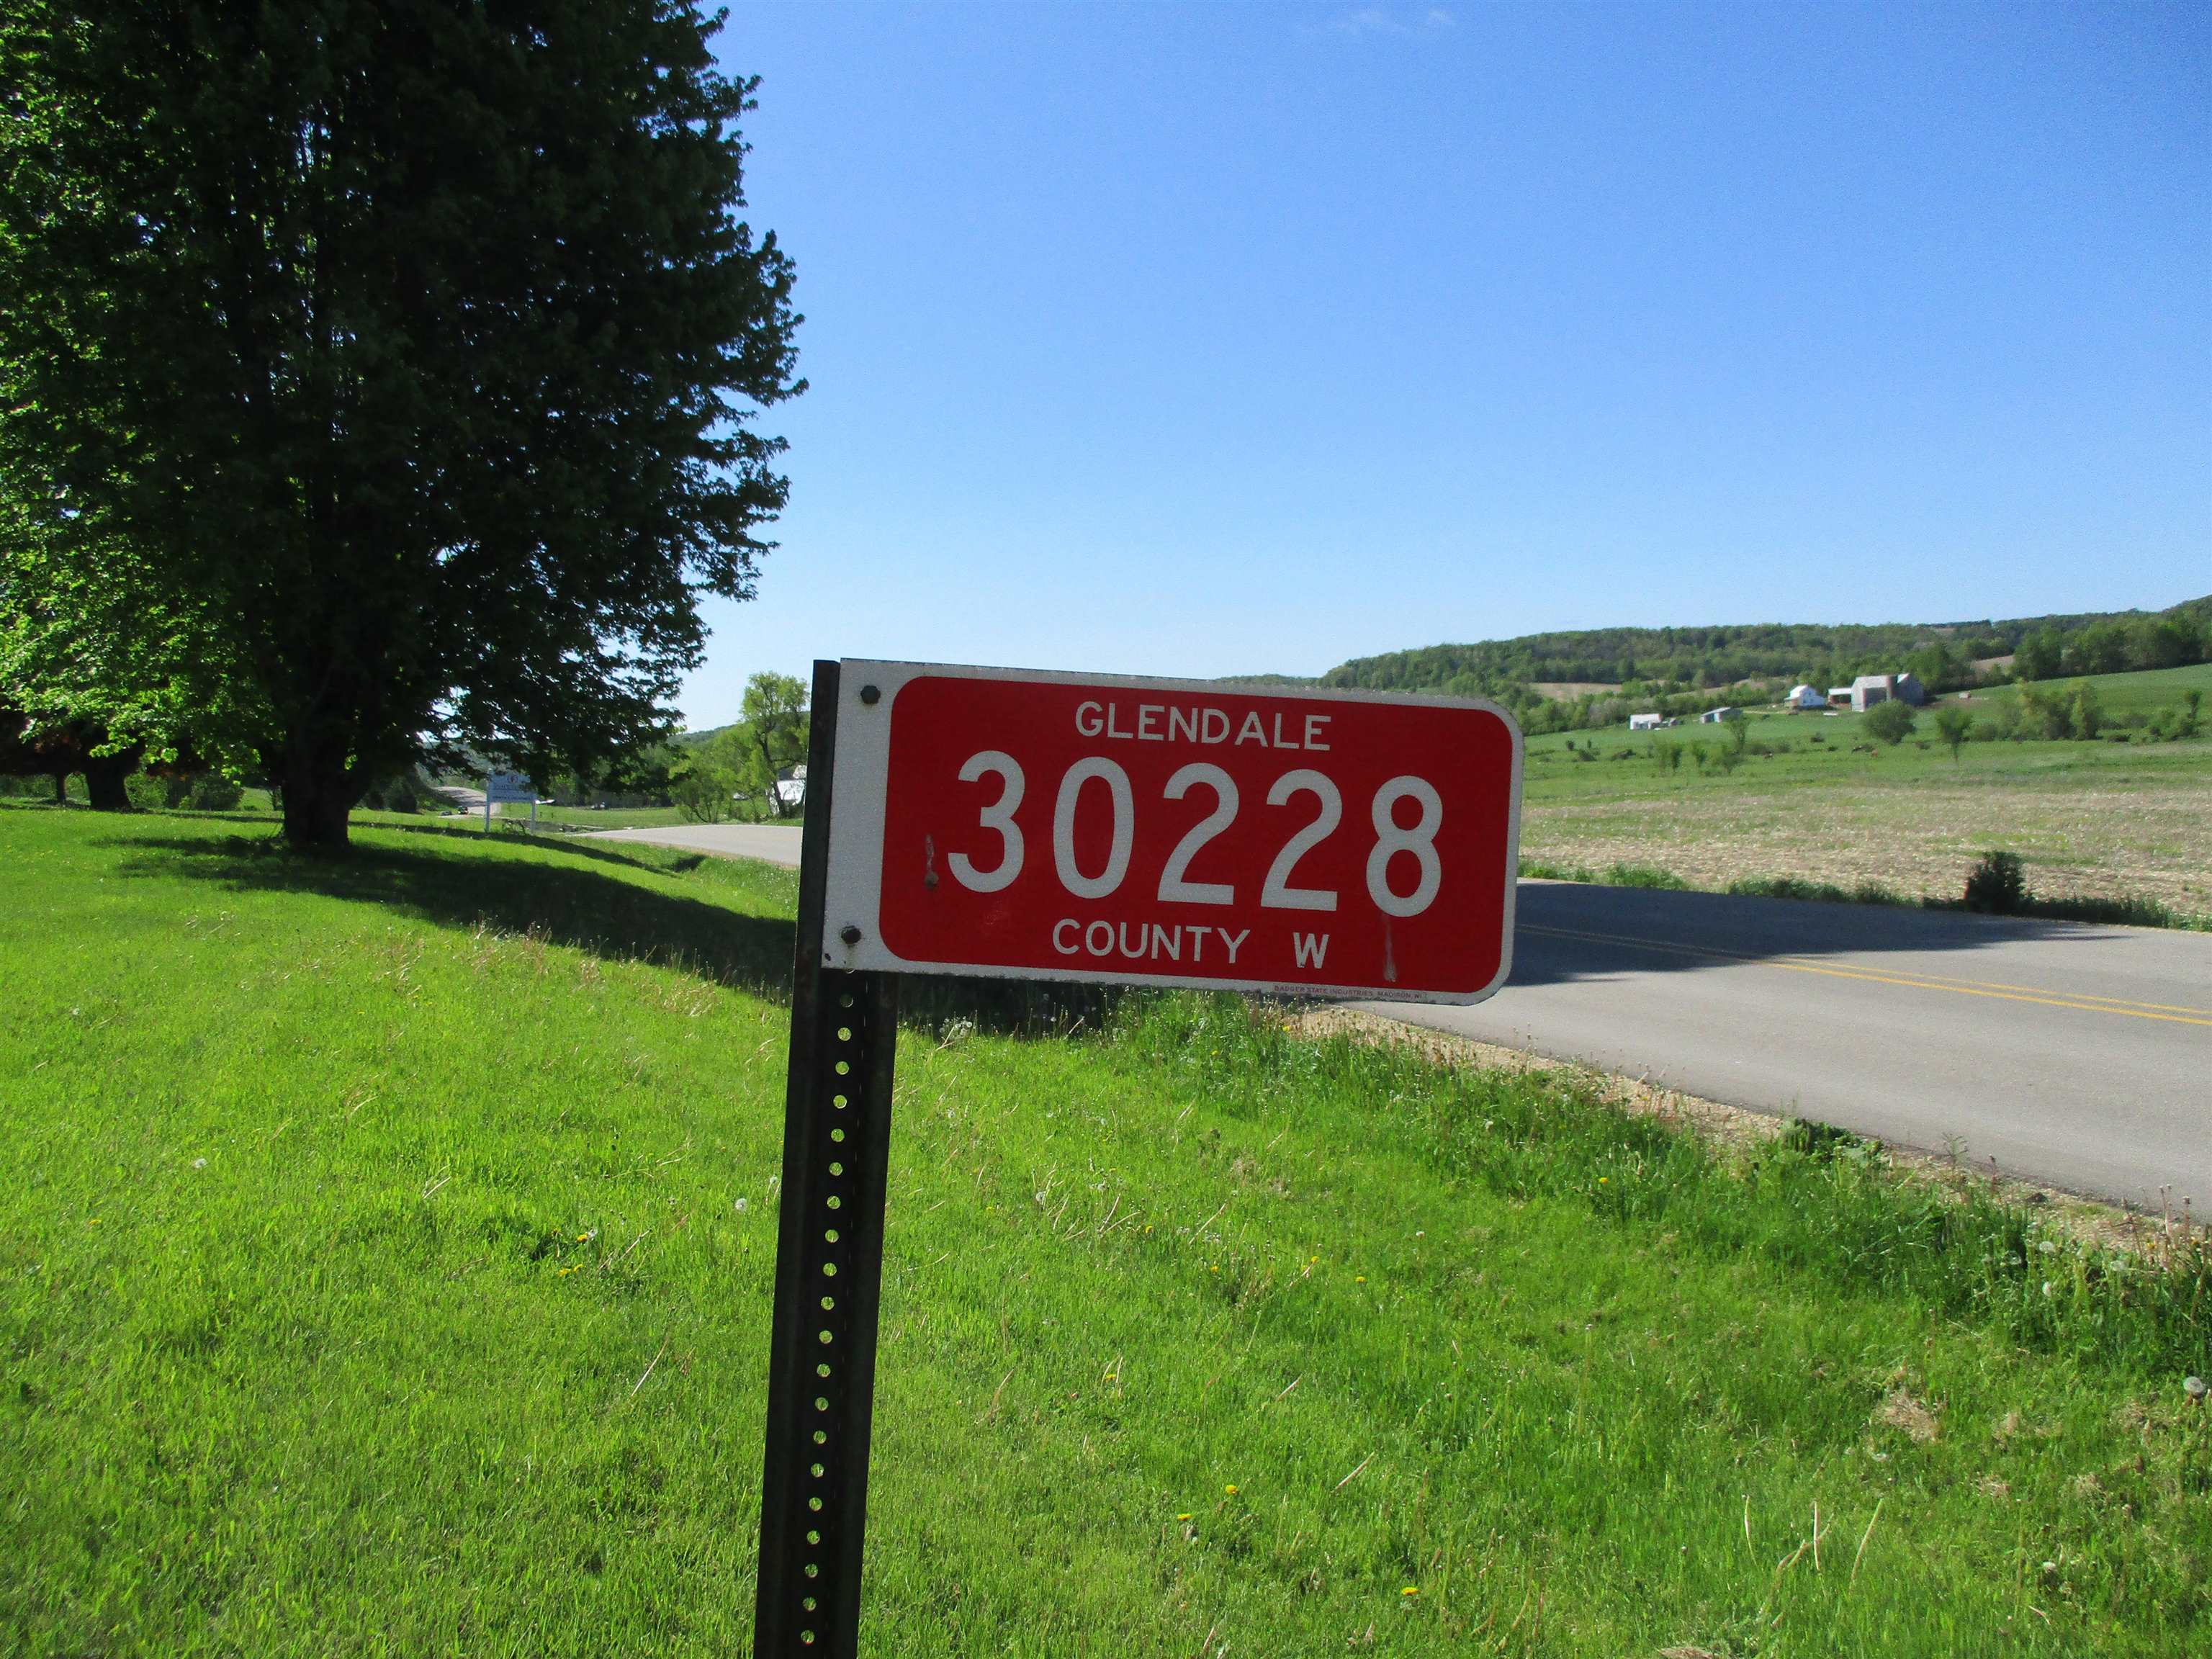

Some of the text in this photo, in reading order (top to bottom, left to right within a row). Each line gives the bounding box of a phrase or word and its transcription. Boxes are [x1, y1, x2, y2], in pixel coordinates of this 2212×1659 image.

[1076, 701, 1331, 751] GLENDALE
[948, 750, 1443, 917] 30228
[1053, 919, 1330, 968] COUNTY W
